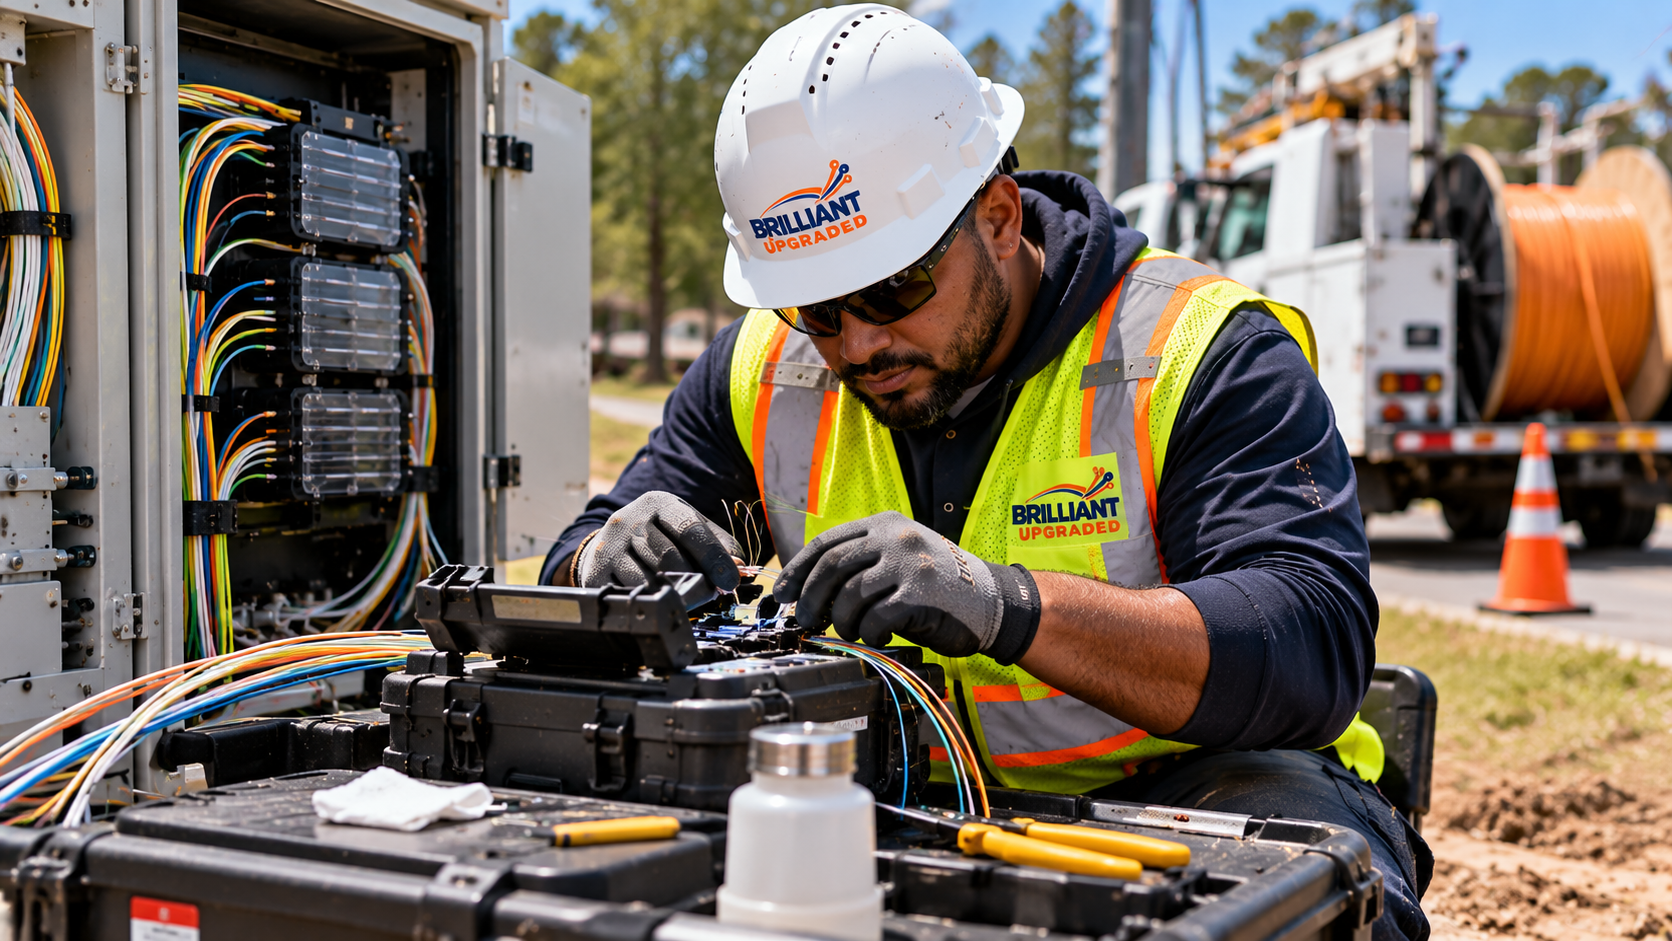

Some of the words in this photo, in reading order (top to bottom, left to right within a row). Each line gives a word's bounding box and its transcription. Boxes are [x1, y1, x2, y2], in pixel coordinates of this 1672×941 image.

[749, 190, 860, 239] BRILLIANT
[763, 214, 867, 254] UPGRADED
[1012, 497, 1119, 525] BRILLIANT
[1019, 520, 1121, 541] UPGRADED
